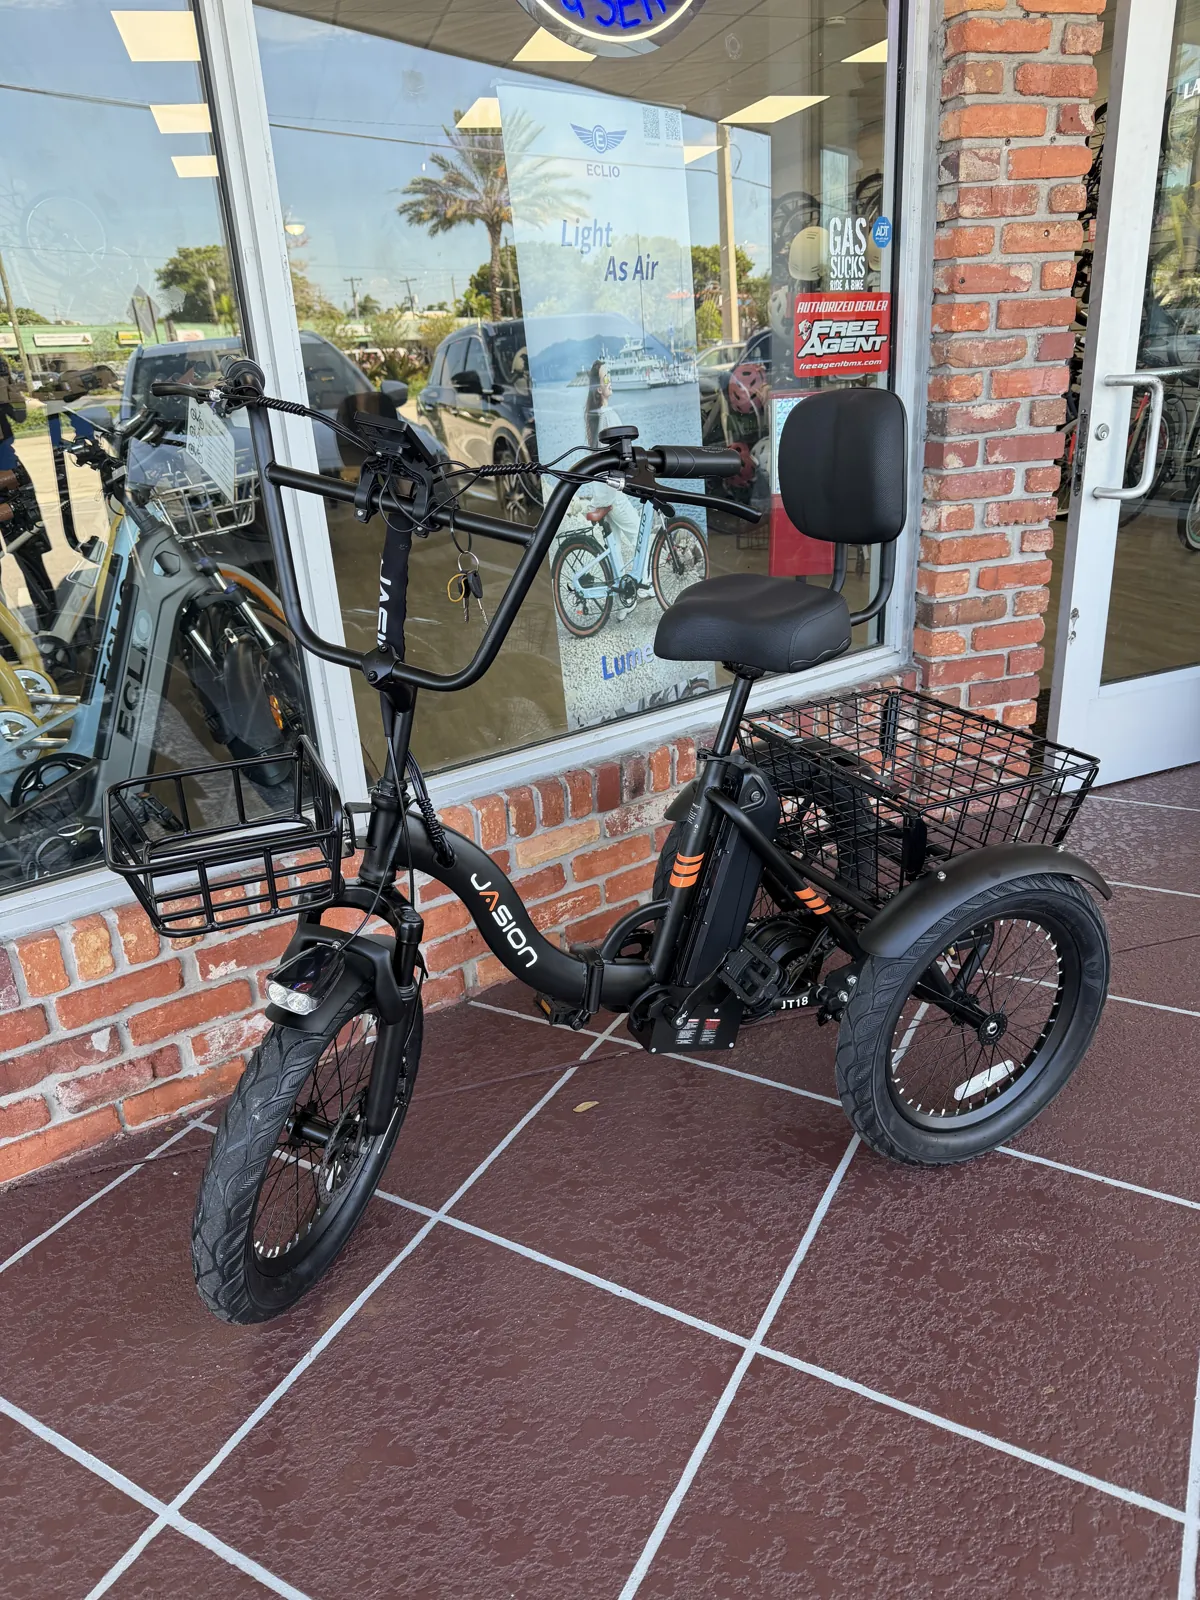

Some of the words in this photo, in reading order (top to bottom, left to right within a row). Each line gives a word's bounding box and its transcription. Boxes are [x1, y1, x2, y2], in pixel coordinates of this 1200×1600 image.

[586, 164, 620, 178] ECLIO
[561, 218, 613, 254] Light
[829, 217, 867, 256] GAS
[875, 225, 890, 237] ADT
[604, 255, 628, 282] As
[632, 253, 659, 281] Air
[830, 255, 866, 279] SUCKS
[830, 280, 843, 291] RIDE
[844, 280, 849, 291] A
[851, 279, 864, 291] BIKE
[797, 300, 855, 314] AUTHORIZED
[855, 299, 889, 312] DEALER
[810, 320, 879, 337] FREE
[797, 334, 888, 357] AGENT
[799, 359, 883, 371] freeagentbmx.com
[470, 873, 538, 968] JASION
[780, 996, 809, 1010] JT18
